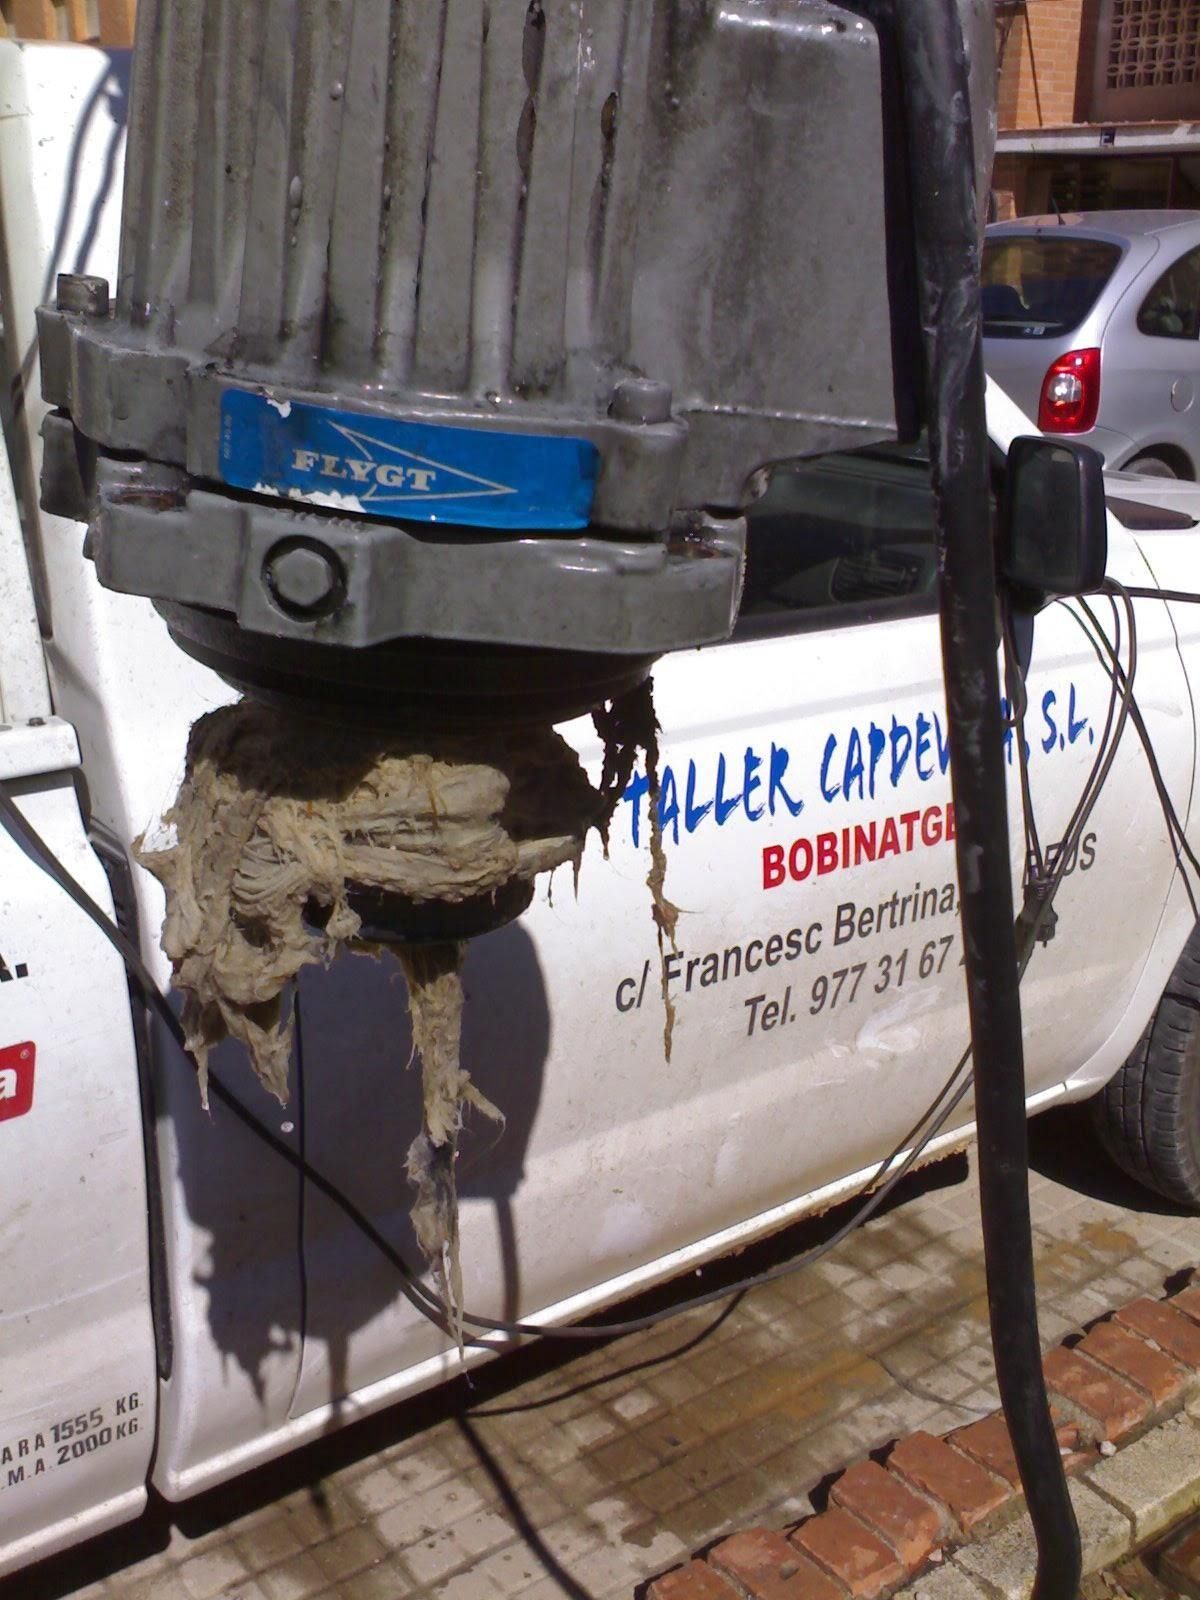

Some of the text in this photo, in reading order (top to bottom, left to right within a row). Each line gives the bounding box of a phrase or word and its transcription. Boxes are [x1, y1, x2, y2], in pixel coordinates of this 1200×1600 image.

[291, 449, 436, 491] FLYGT
[623, 741, 804, 848] TALLER
[1041, 682, 1094, 754] S.L.
[615, 959, 650, 1013] c/
[662, 922, 823, 1000] Francesc
[744, 935, 954, 1036] Tel. 977 31 67
[50, 1407, 104, 1443] 1555
[57, 1427, 112, 1465] 2000
